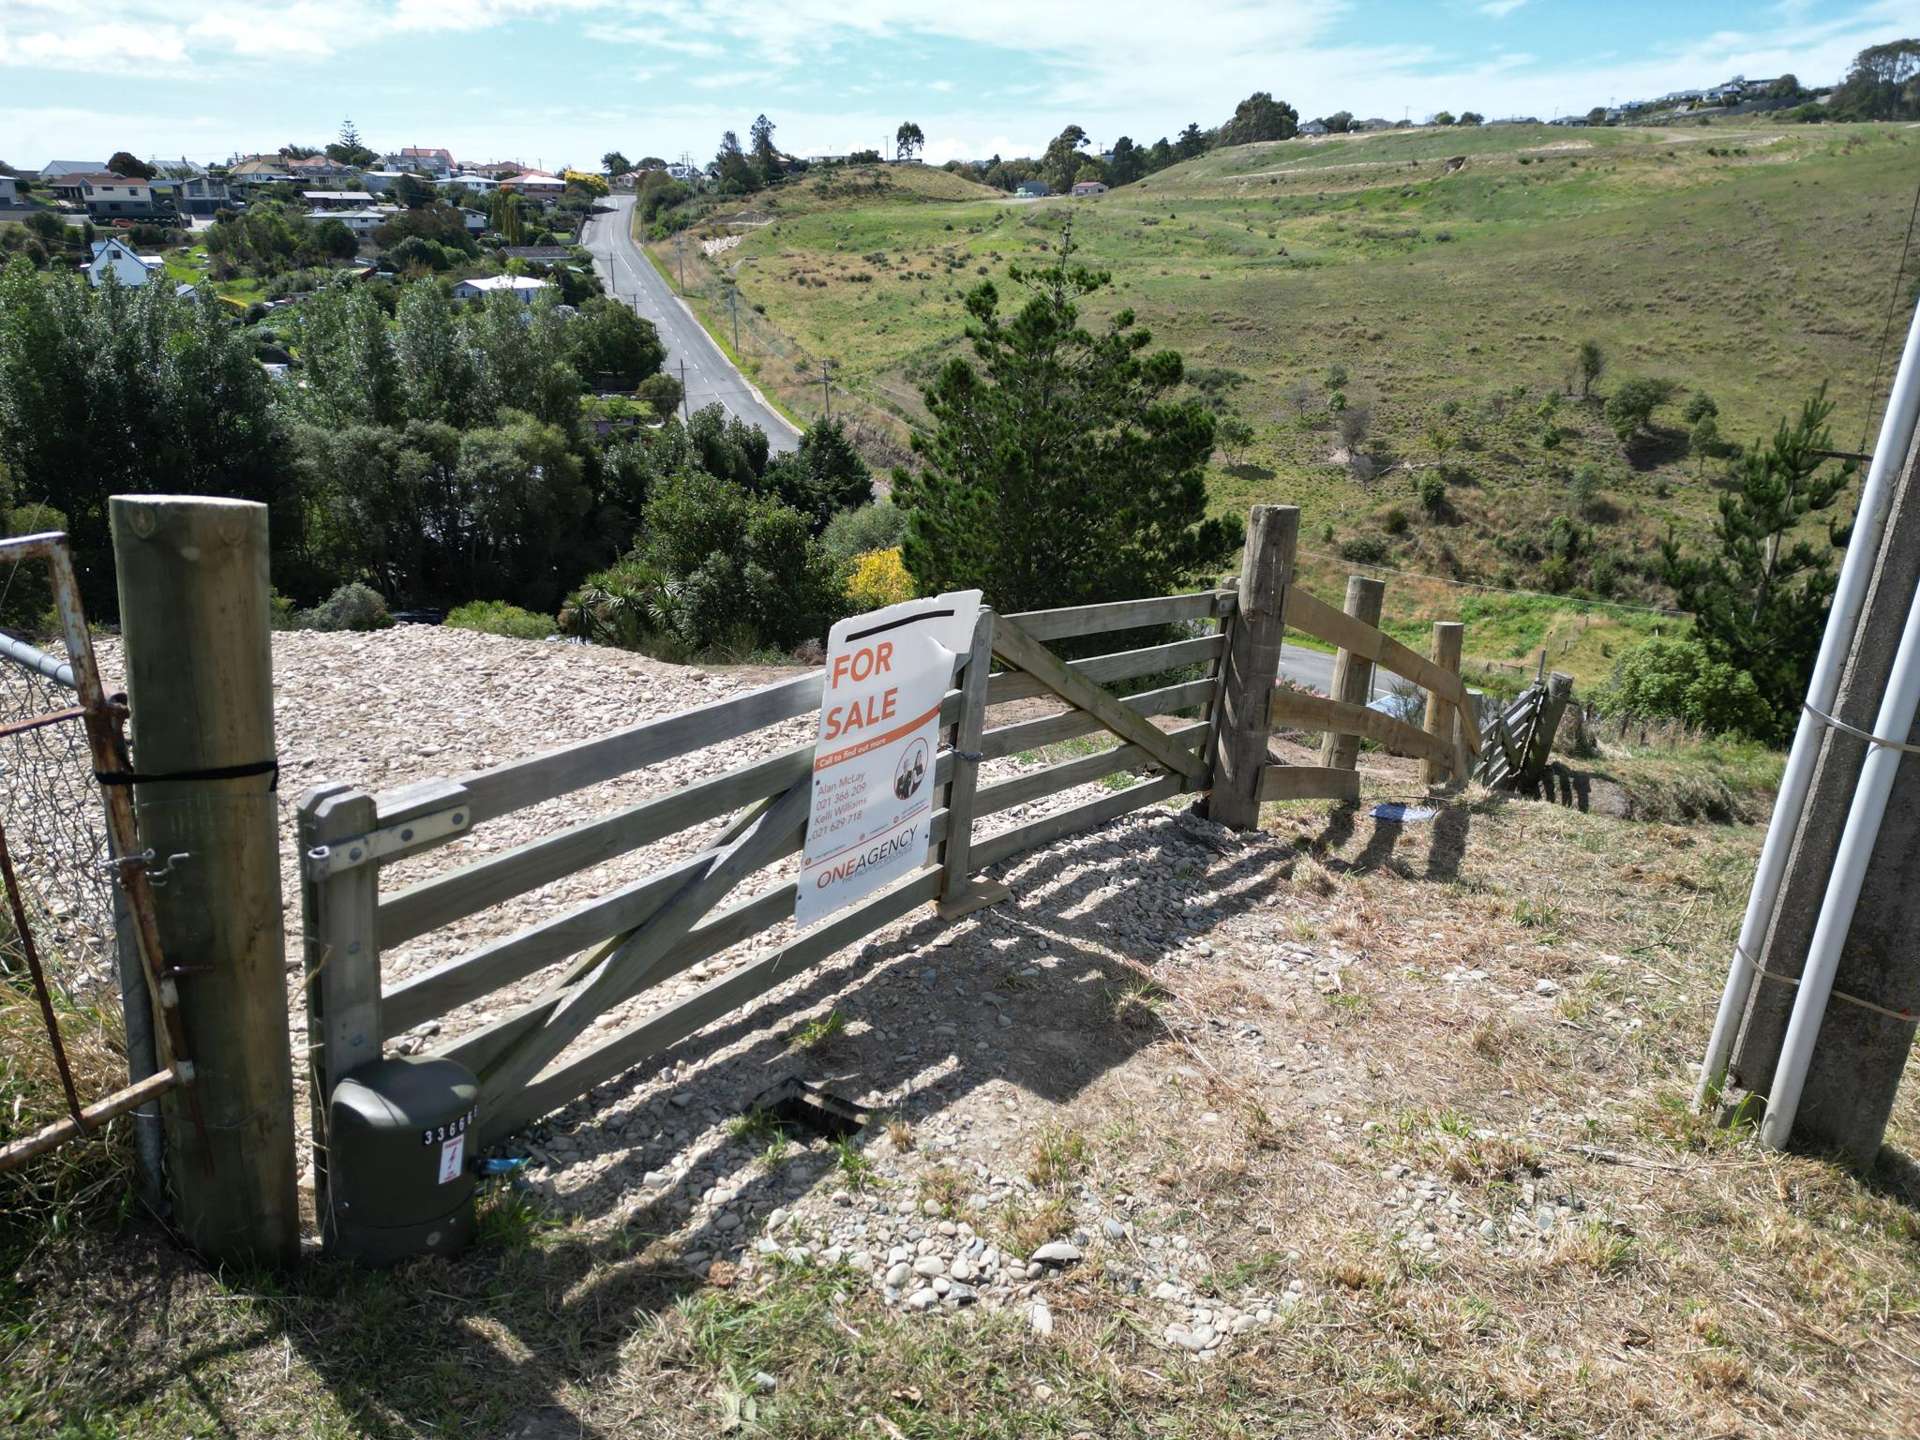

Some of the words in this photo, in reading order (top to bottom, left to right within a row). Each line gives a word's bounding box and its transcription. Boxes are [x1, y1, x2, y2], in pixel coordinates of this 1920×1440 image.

[832, 641, 893, 689] FOR
[824, 687, 898, 740] SALE
[870, 738, 887, 748] more
[817, 784, 836, 796] Alan
[816, 798, 831, 811] 021
[811, 826, 828, 840] 021
[817, 824, 918, 889] ONEAGENCY
